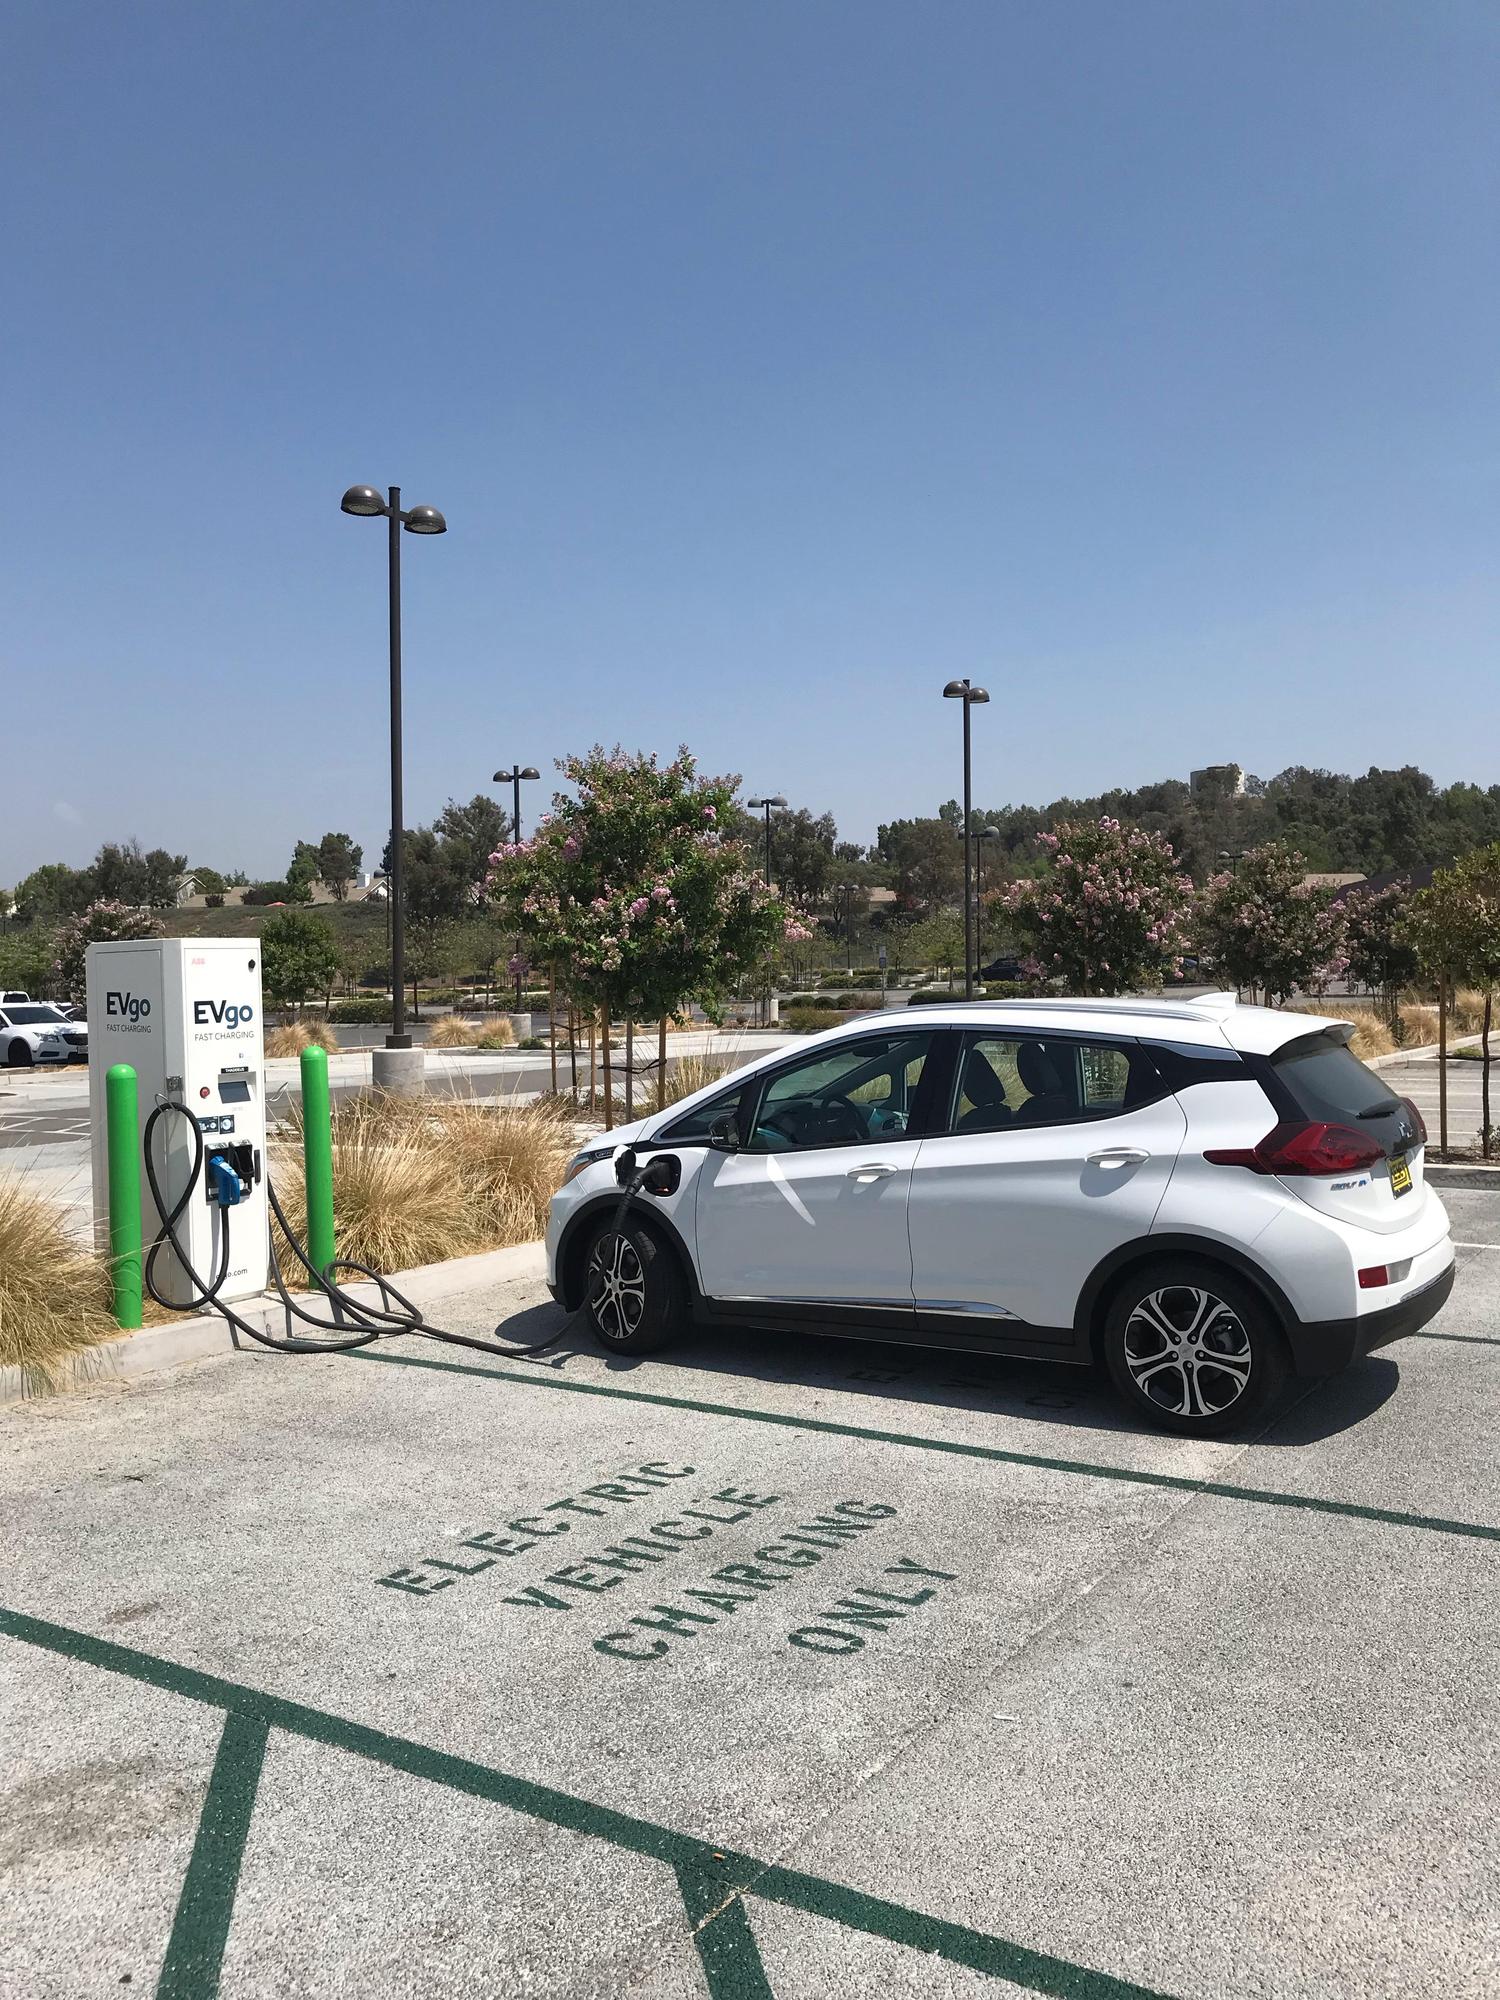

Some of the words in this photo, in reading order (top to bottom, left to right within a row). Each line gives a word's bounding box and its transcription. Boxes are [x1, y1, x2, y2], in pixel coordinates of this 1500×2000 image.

[106, 991, 151, 1023] EVgo
[106, 1023, 120, 1032] FAST
[120, 1024, 152, 1033] CHARGING
[193, 999, 253, 1030] EVgo
[194, 1032, 213, 1041] FAST
[214, 1030, 255, 1041] CHARGING
[374, 1461, 696, 1596] ELECTRIC
[500, 1488, 780, 1610] VEHICLE
[593, 1500, 898, 1661] CHARGING
[787, 1557, 960, 1655] ONLY
